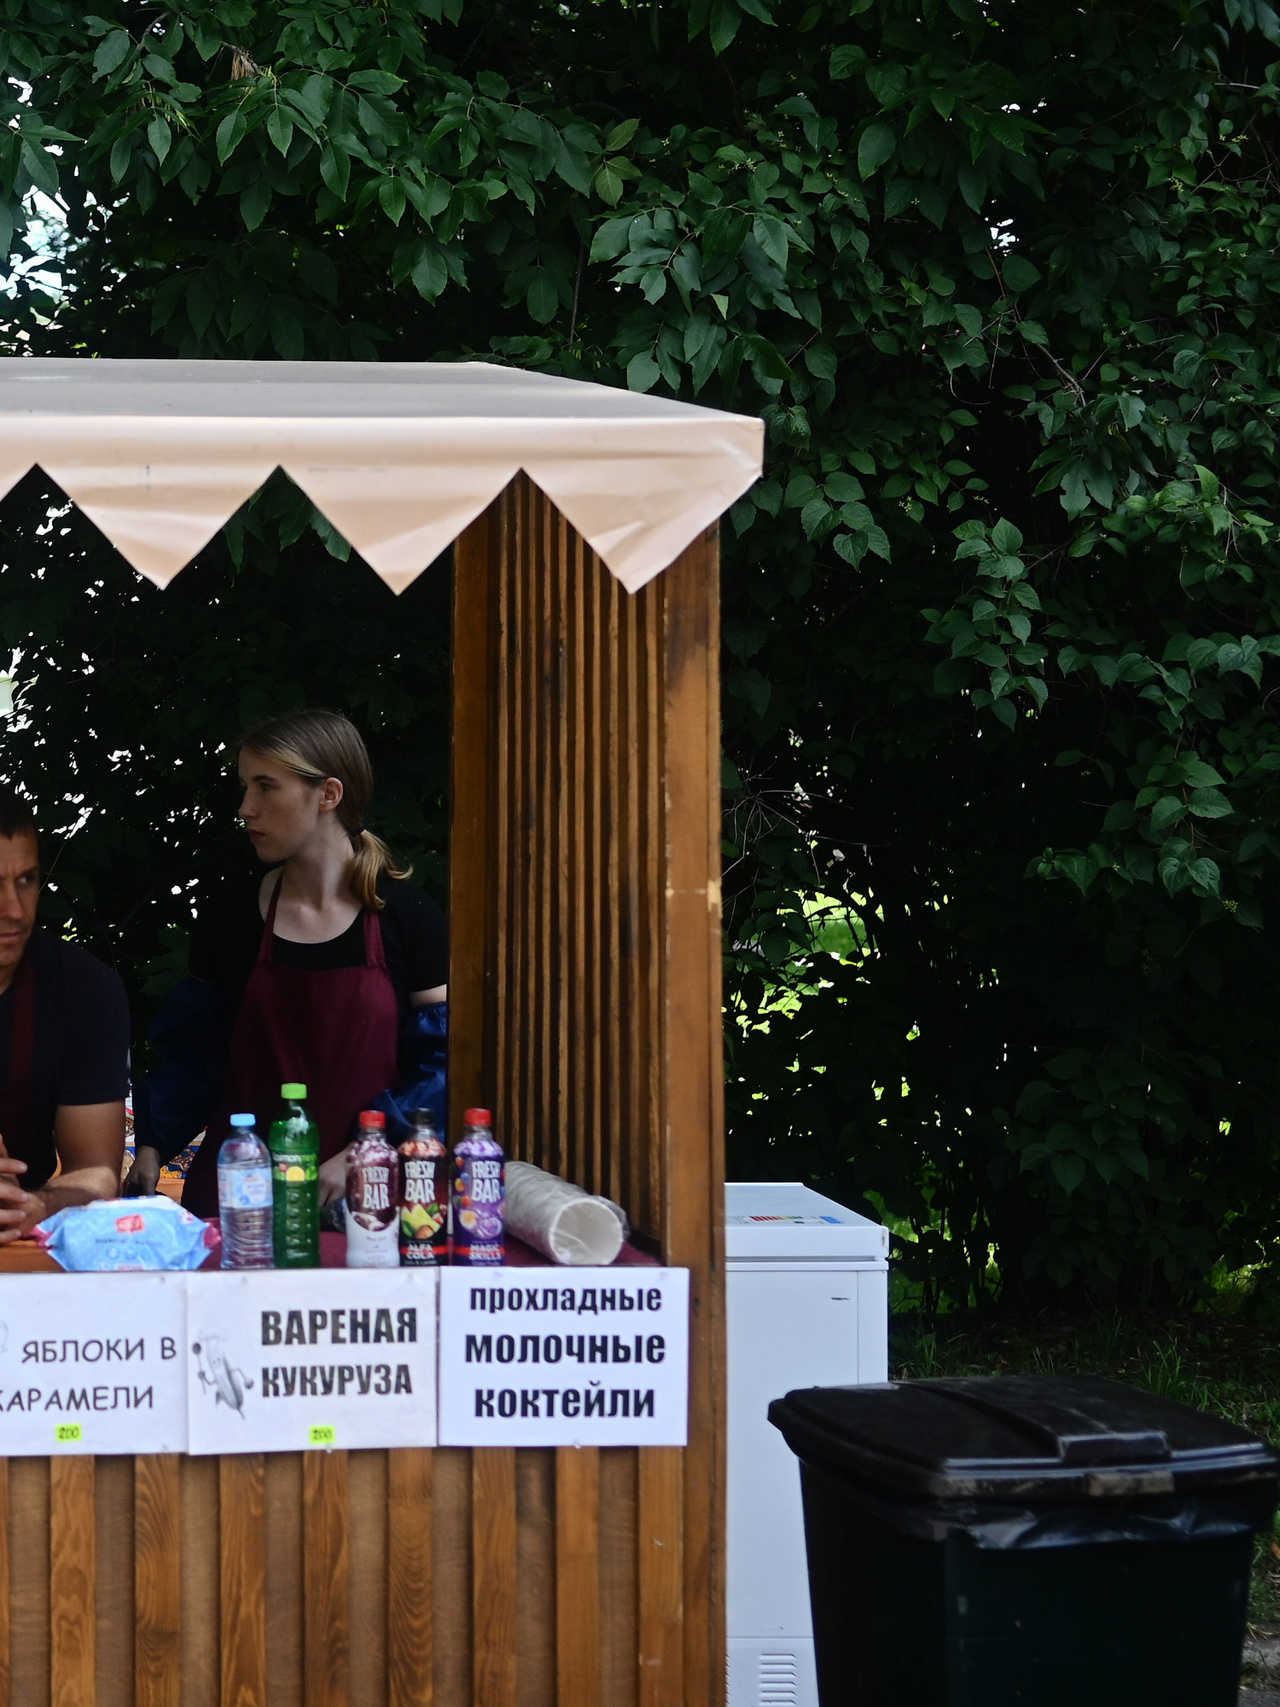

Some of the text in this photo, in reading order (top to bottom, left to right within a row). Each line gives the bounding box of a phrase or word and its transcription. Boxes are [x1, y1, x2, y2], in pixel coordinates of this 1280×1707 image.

[362, 1166, 390, 1183] FRESH
[404, 1161, 436, 1179] FRESH
[471, 1161, 501, 1179] FRESH
[362, 1184, 390, 1210] BAR
[404, 1179, 436, 1203] BAR
[471, 1179, 501, 1203] BAR
[406, 1251, 435, 1259] COLA
[470, 1287, 662, 1316] прохладные
[261, 1307, 417, 1346] ВАРЕНАЯ
[21, 1336, 177, 1364] ЯБЛОКИ В
[465, 1334, 665, 1364] молочные
[261, 1363, 413, 1398] КУКУРУЗА
[474, 1380, 655, 1418] коктейли
